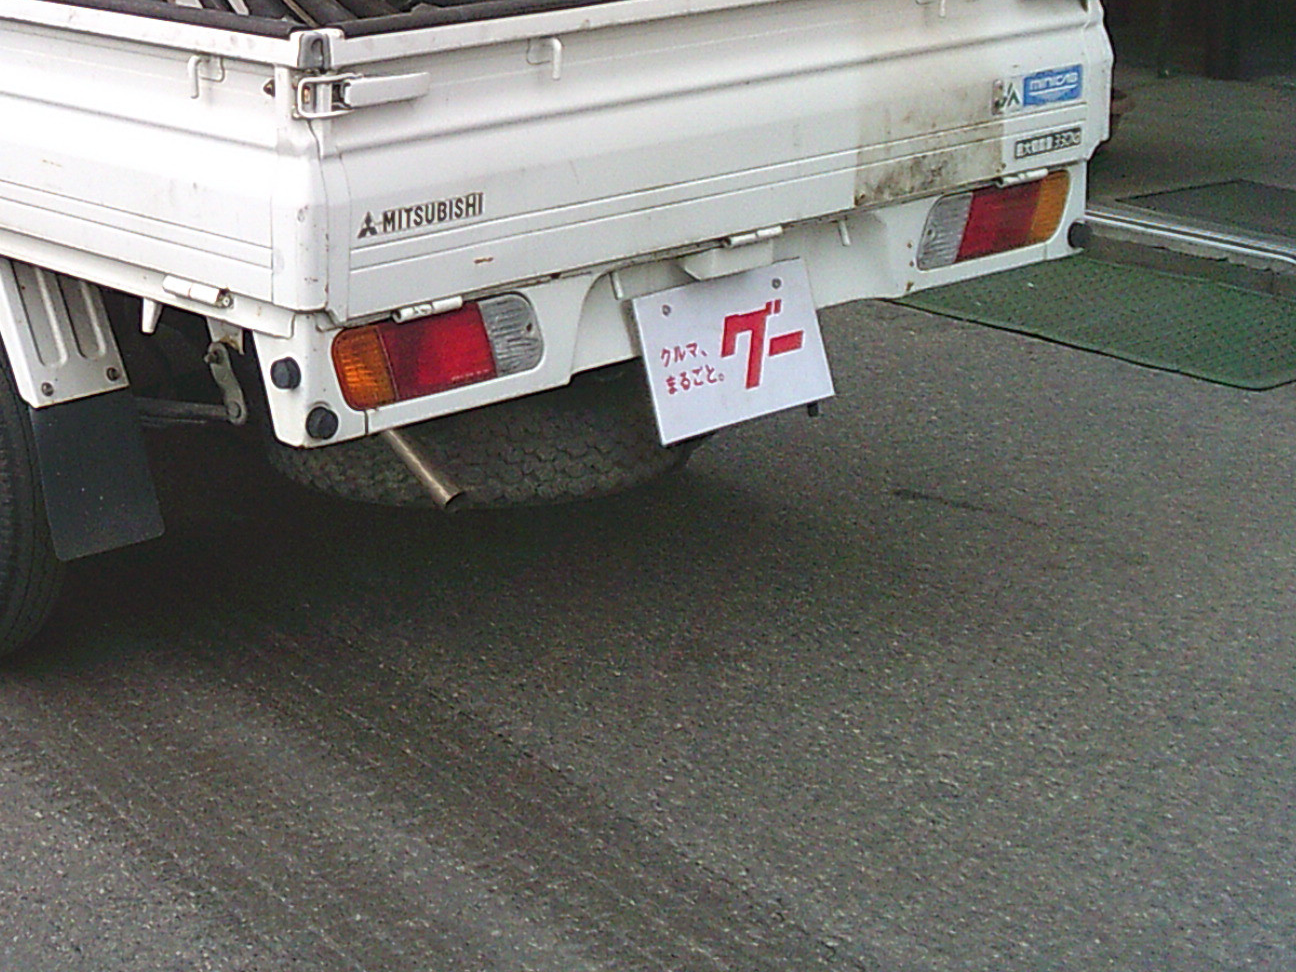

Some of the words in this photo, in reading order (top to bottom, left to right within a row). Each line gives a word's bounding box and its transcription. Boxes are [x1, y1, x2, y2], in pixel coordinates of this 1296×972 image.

[382, 192, 484, 233] MITSUBISHI
[660, 342, 708, 368] クルマ、
[720, 299, 804, 390] グー
[665, 364, 725, 395] まるごと。
